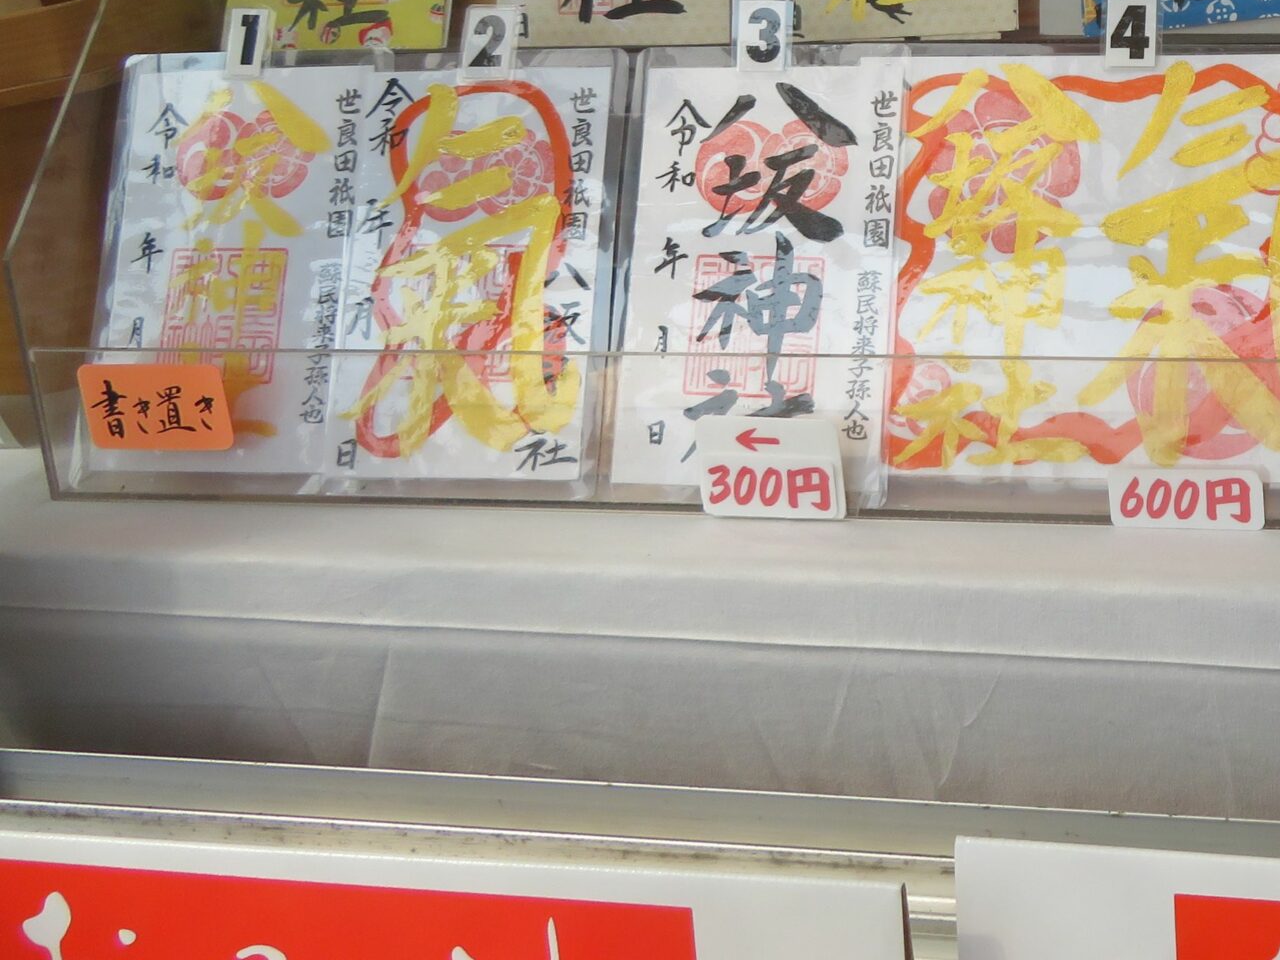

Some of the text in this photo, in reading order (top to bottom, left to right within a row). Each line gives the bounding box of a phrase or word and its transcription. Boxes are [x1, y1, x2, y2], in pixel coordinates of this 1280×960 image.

[238, 13, 261, 66] 1
[467, 14, 503, 68] 2
[746, 6, 782, 63] 3
[1109, 5, 1149, 60] 4
[326, 87, 364, 240] 世良田祇園
[560, 87, 598, 241] 世良田祇園
[862, 89, 899, 251] 世良田祇園
[893, 62, 1101, 470] 八坂神社
[90, 380, 216, 441] 書き置き
[707, 464, 832, 512] 300円
[1118, 476, 1252, 523] 600円
